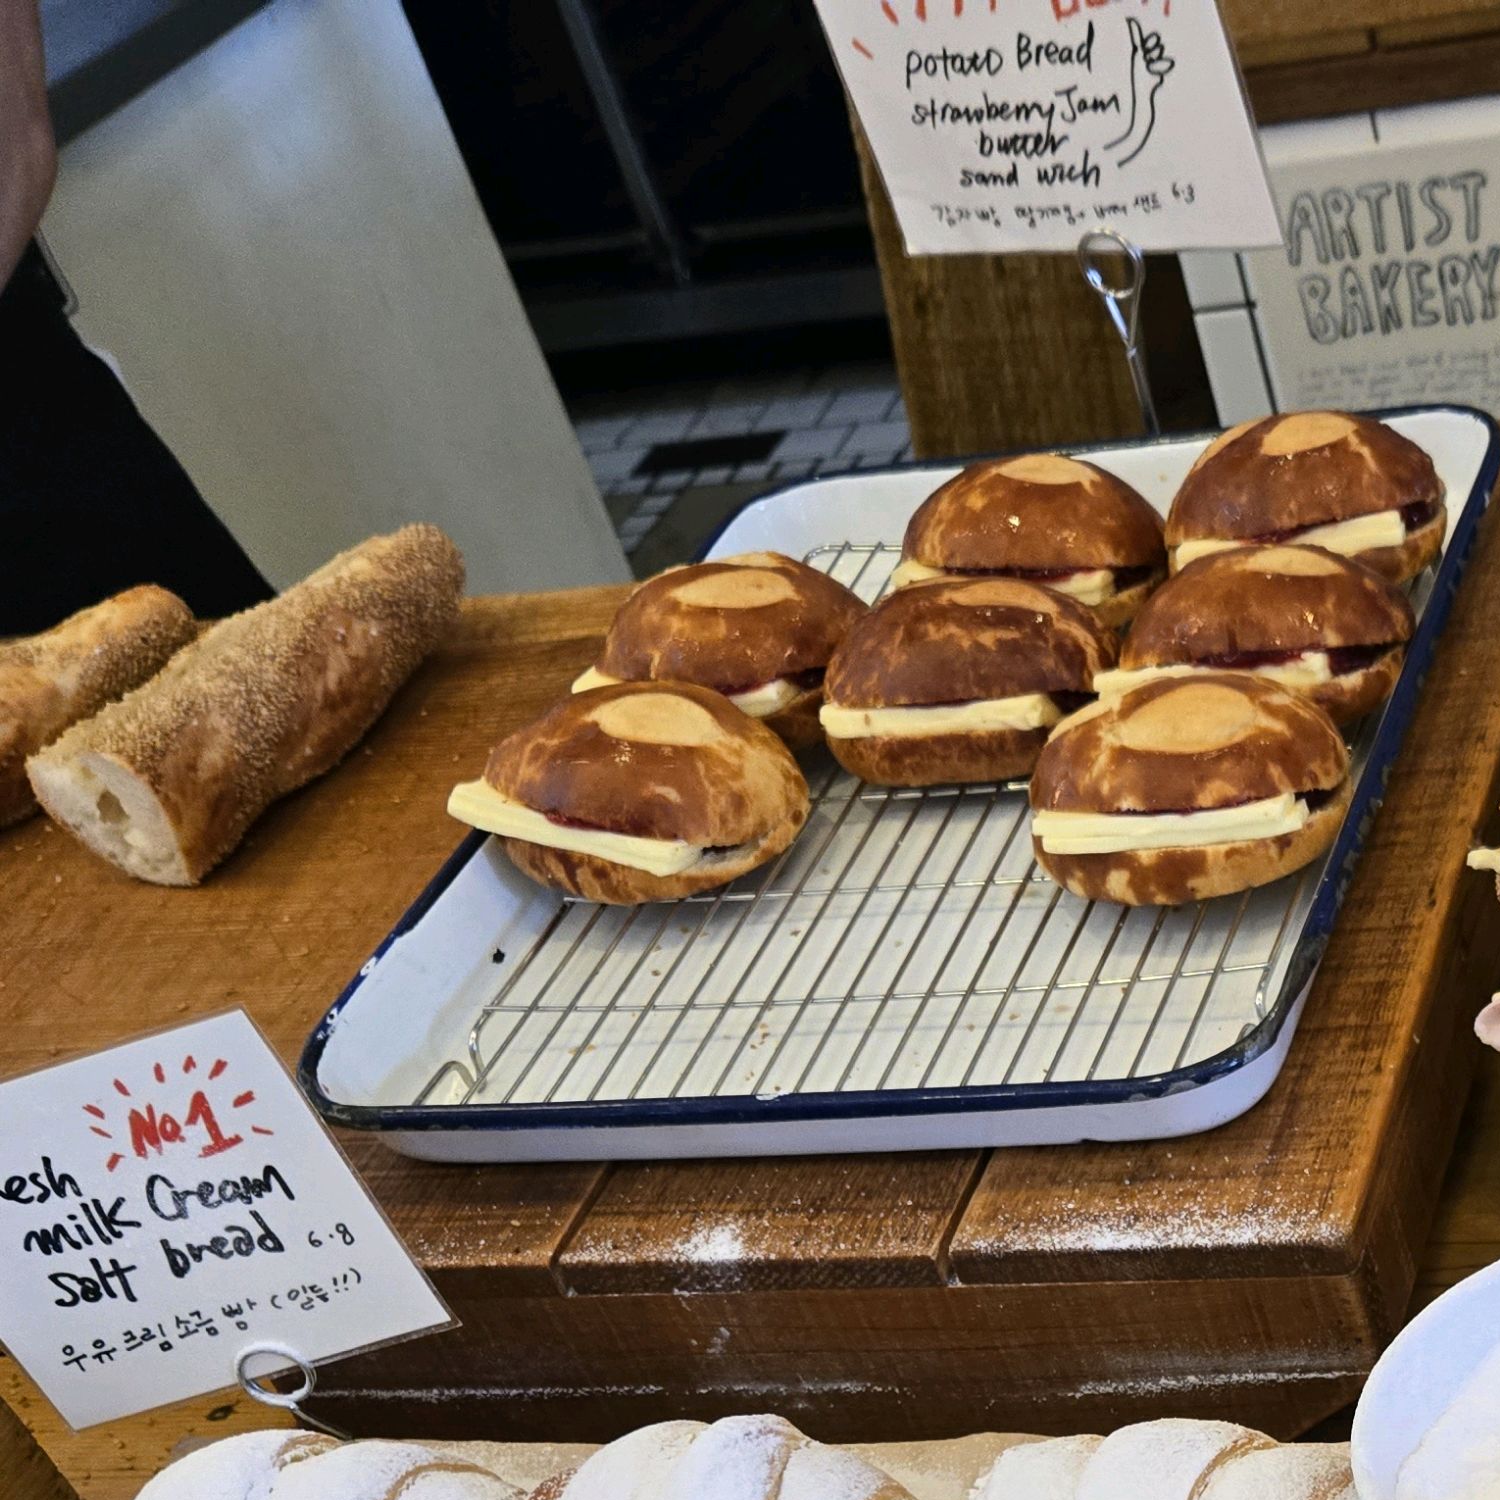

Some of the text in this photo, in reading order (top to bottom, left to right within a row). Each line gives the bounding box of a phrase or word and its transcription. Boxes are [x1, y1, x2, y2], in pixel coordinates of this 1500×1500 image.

[1016, 20, 1095, 74] Bread
[911, 84, 1122, 138] strawberry Jam
[979, 130, 1070, 158] butter
[1287, 168, 1487, 267] ARTIST
[0, 1156, 83, 1205] esh
[23, 1164, 296, 1256] milk Cream
[159, 1209, 286, 1279] bread
[307, 1222, 356, 1249] 6.8
